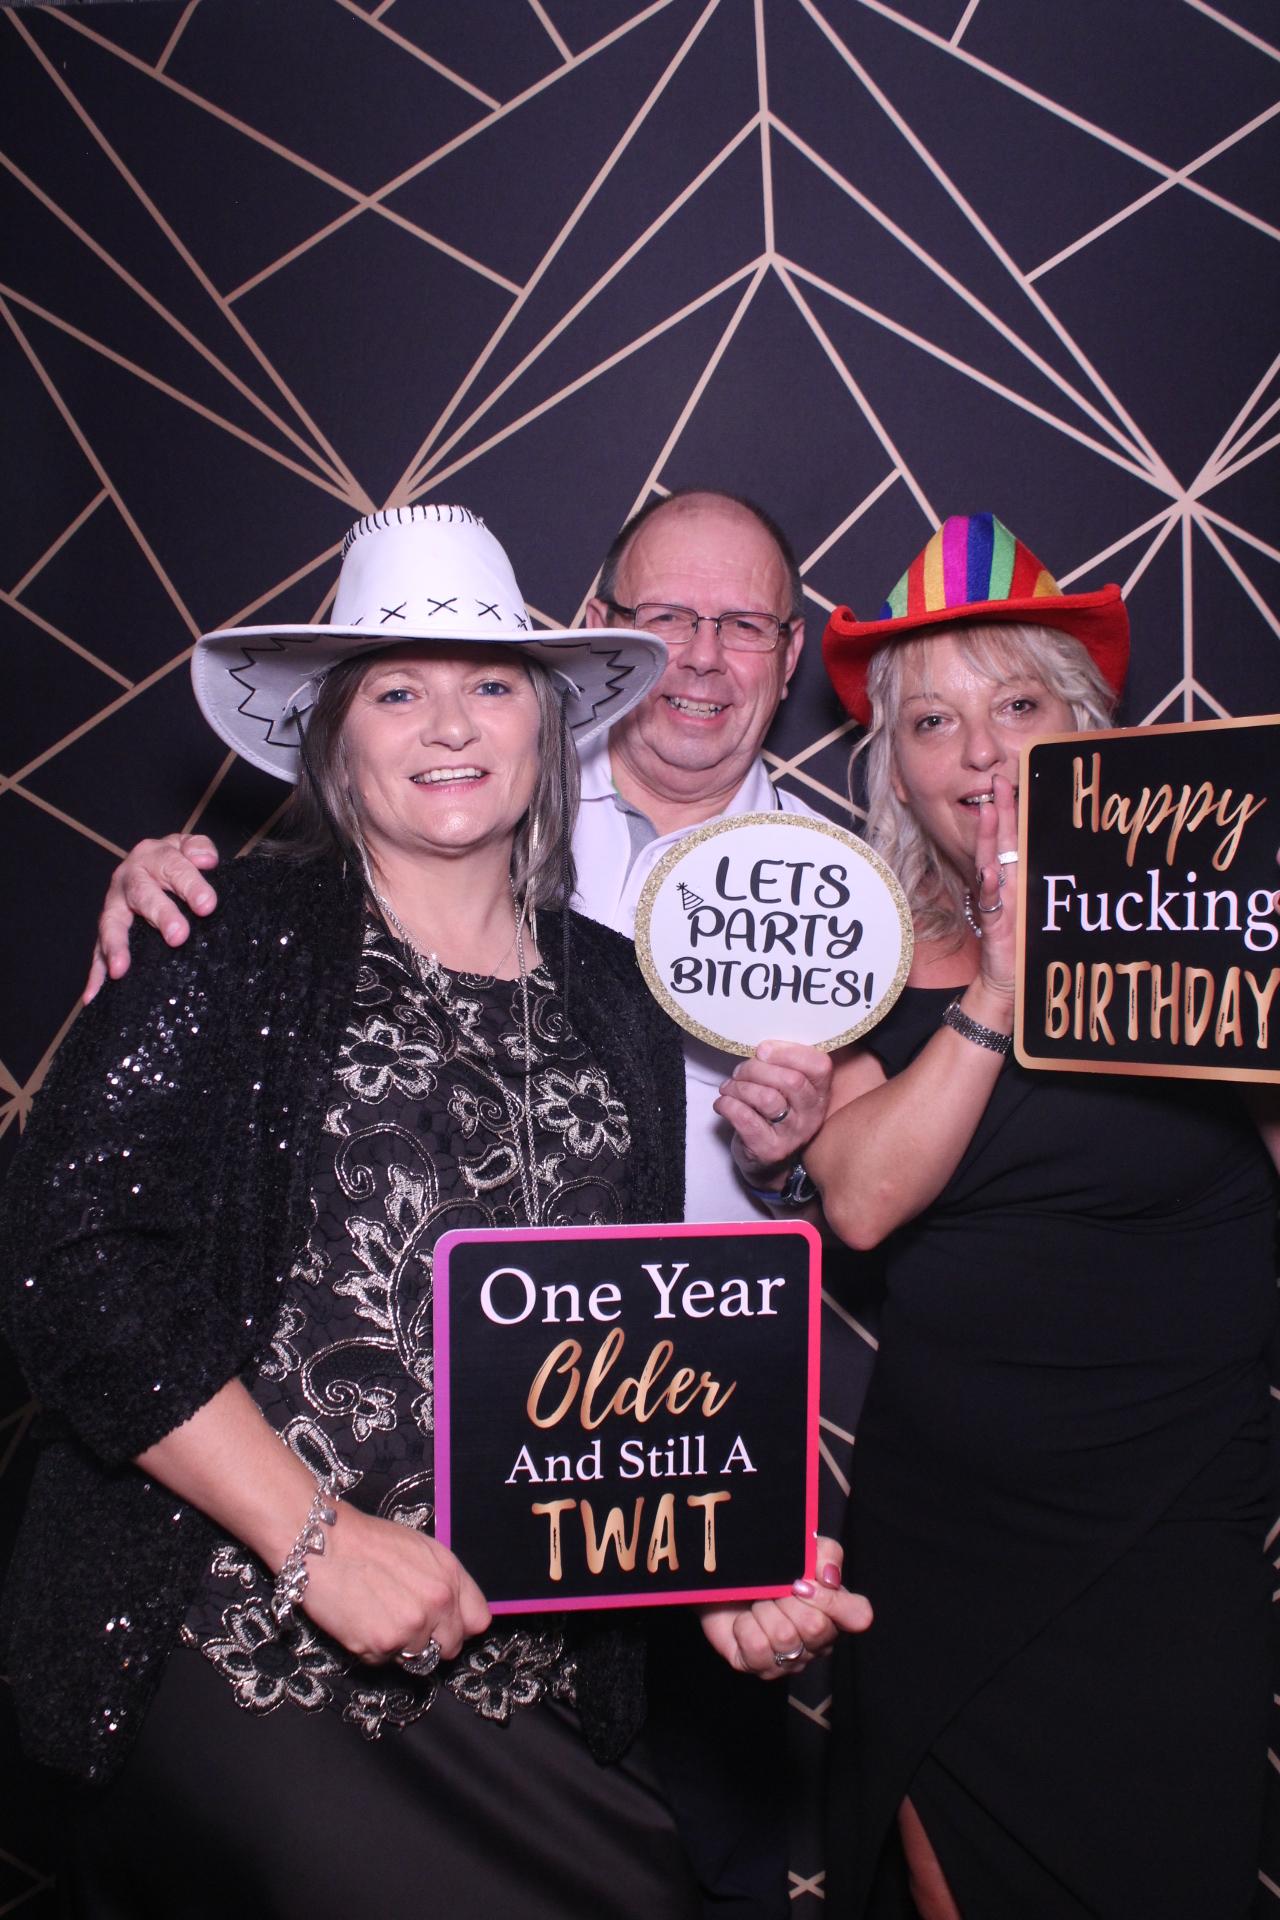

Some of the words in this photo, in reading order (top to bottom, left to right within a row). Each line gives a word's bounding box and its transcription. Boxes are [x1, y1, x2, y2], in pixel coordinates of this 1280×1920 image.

[1072, 752, 1267, 871] Happy
[715, 856, 850, 909] LETS
[1041, 869, 1279, 951] Fucking
[687, 905, 863, 959] PARTY
[670, 956, 874, 1009] BITCHES!
[1045, 961, 1280, 1048] BIRTHDAY
[480, 1267, 622, 1325] One
[641, 1263, 785, 1320] Year
[526, 1327, 737, 1430] Older
[504, 1439, 603, 1484] And
[619, 1435, 706, 1479] Still
[719, 1435, 757, 1474] A
[531, 1491, 731, 1581] TWAT
